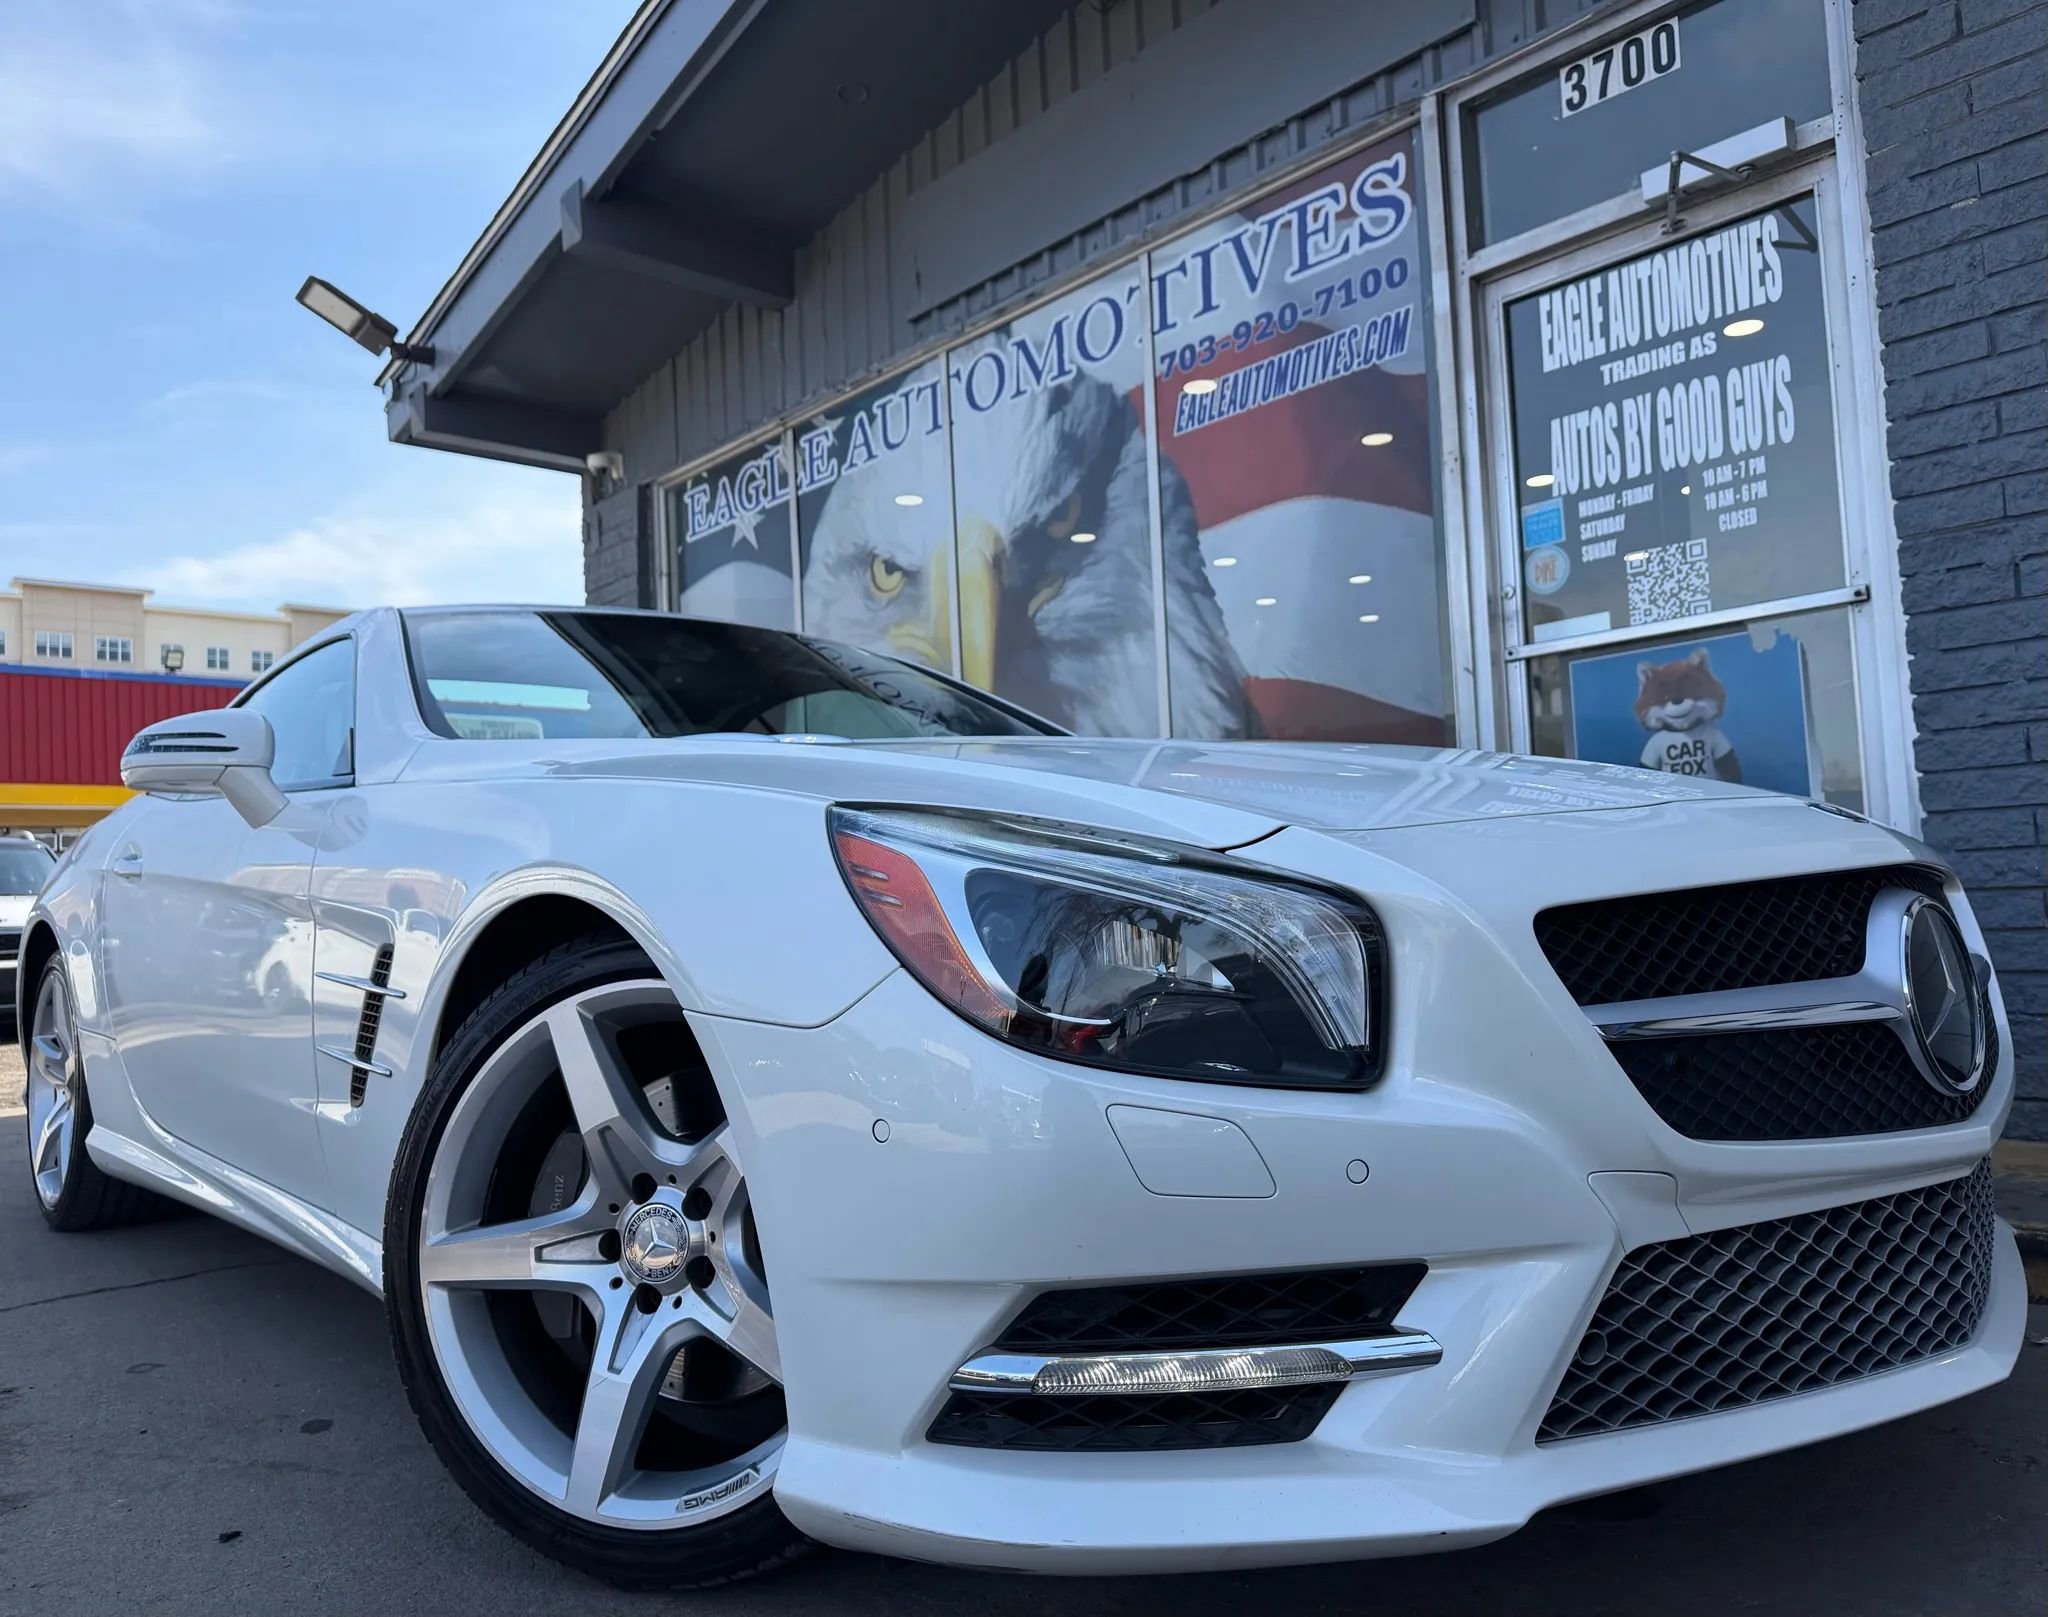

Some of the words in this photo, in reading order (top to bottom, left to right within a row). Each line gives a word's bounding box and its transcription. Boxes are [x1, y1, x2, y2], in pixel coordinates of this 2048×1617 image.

[1564, 23, 1676, 112] 3700
[1539, 276, 1606, 374] EAGLE
[1608, 214, 1783, 353] AUTOMOTIVES
[1160, 257, 1409, 380] 703-920-7100
[685, 427, 838, 541] EAGLE
[842, 153, 1411, 475] AUTOMOTIVES
[1600, 341, 1686, 386] TRADING
[1689, 331, 1717, 360] AS
[1175, 305, 1413, 435] EAGLEAUTOMOTIVES.COM
[1551, 402, 1621, 497] AUTOS
[1622, 392, 1652, 480] BY
[1656, 374, 1724, 472] GOOD
[1726, 354, 1795, 455] GUYS
[1702, 468, 1715, 488] 10
[1716, 463, 1732, 485] AM
[1739, 460, 1746, 479] 7
[1749, 455, 1766, 477] PM
[1579, 493, 1615, 519] MONDAY
[1622, 483, 1654, 508] FRIDAY
[1704, 491, 1717, 511] 10
[1718, 487, 1735, 508] AM
[1742, 483, 1750, 503] 6
[1750, 480, 1768, 501] PM
[1580, 514, 1625, 541] SATURDAY
[1719, 507, 1757, 532] CLOSED
[1582, 538, 1616, 563] SUNDAY
[1666, 740, 1705, 761] CAR
[1670, 759, 1706, 776] FOX
[630, 1207, 673, 1232] MERCEDES
[650, 1264, 675, 1278] BENZ
